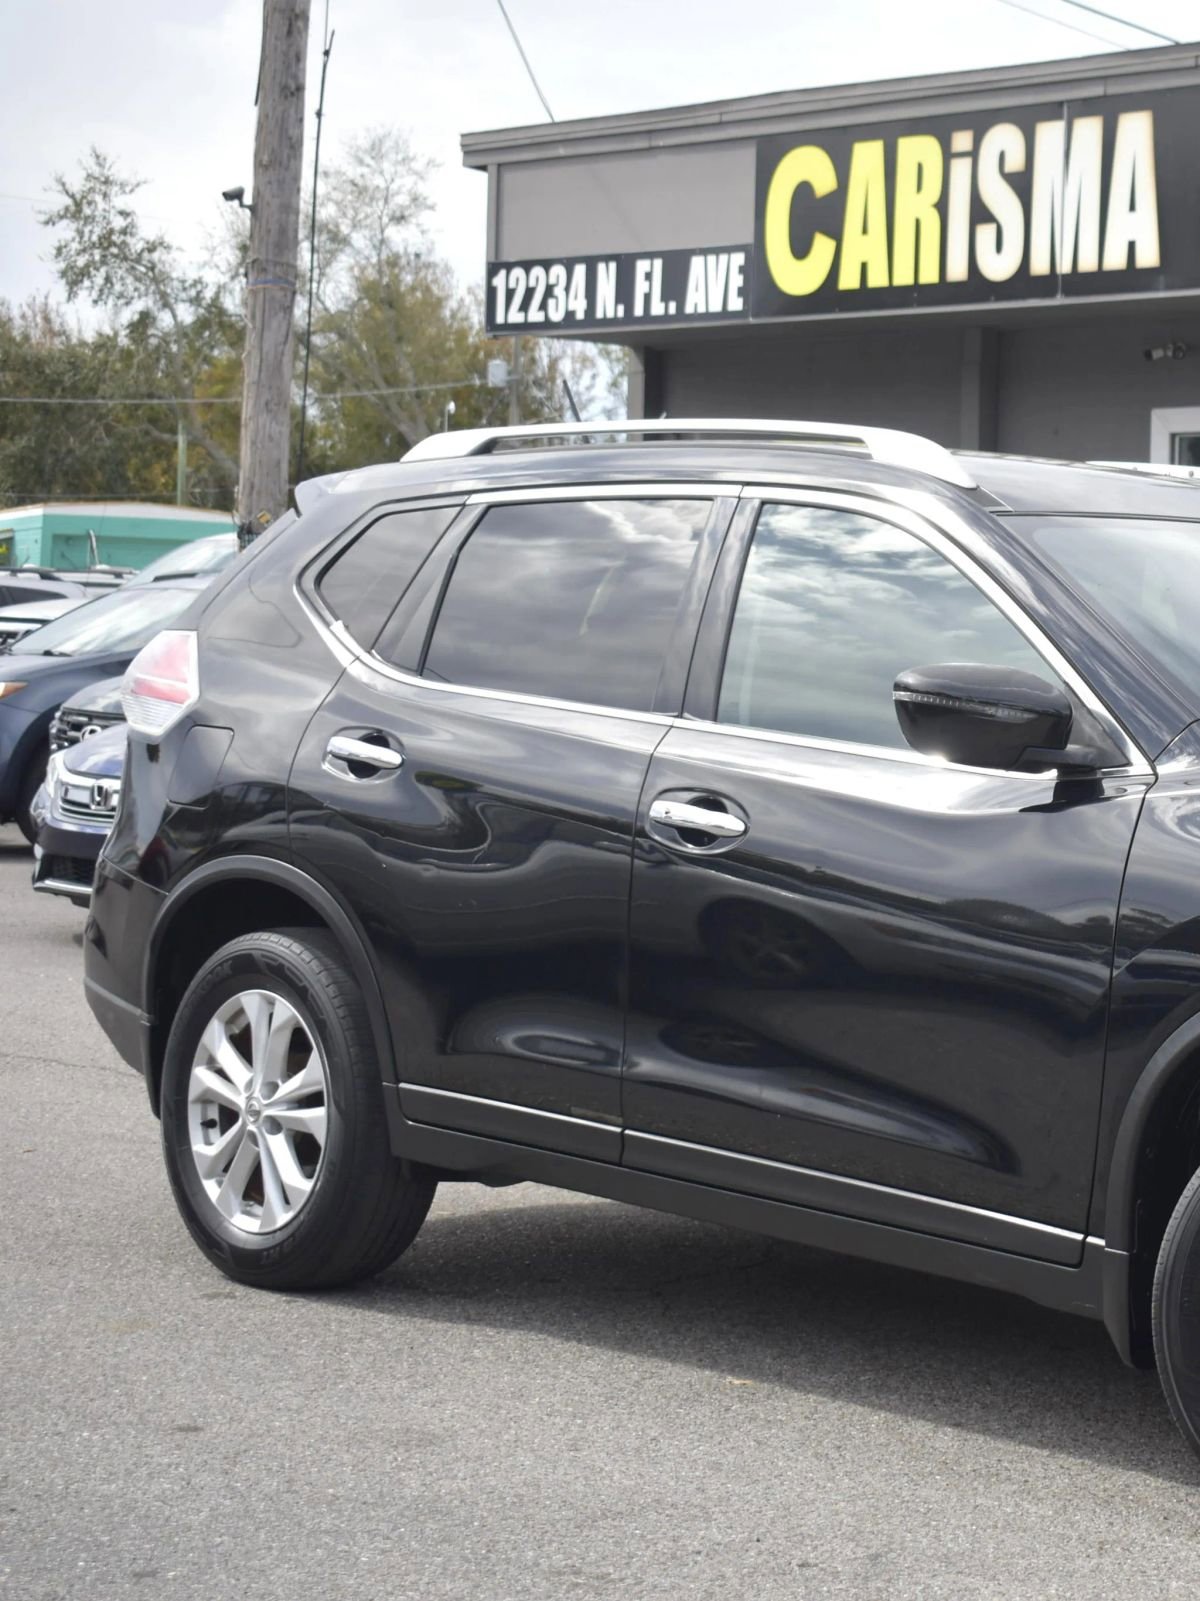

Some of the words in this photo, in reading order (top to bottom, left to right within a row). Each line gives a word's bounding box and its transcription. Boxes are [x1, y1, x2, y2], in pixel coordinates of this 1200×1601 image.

[491, 263, 588, 325] 12234
[595, 260, 625, 320] N.
[633, 257, 677, 318] FL.
[684, 251, 746, 315] AVE
